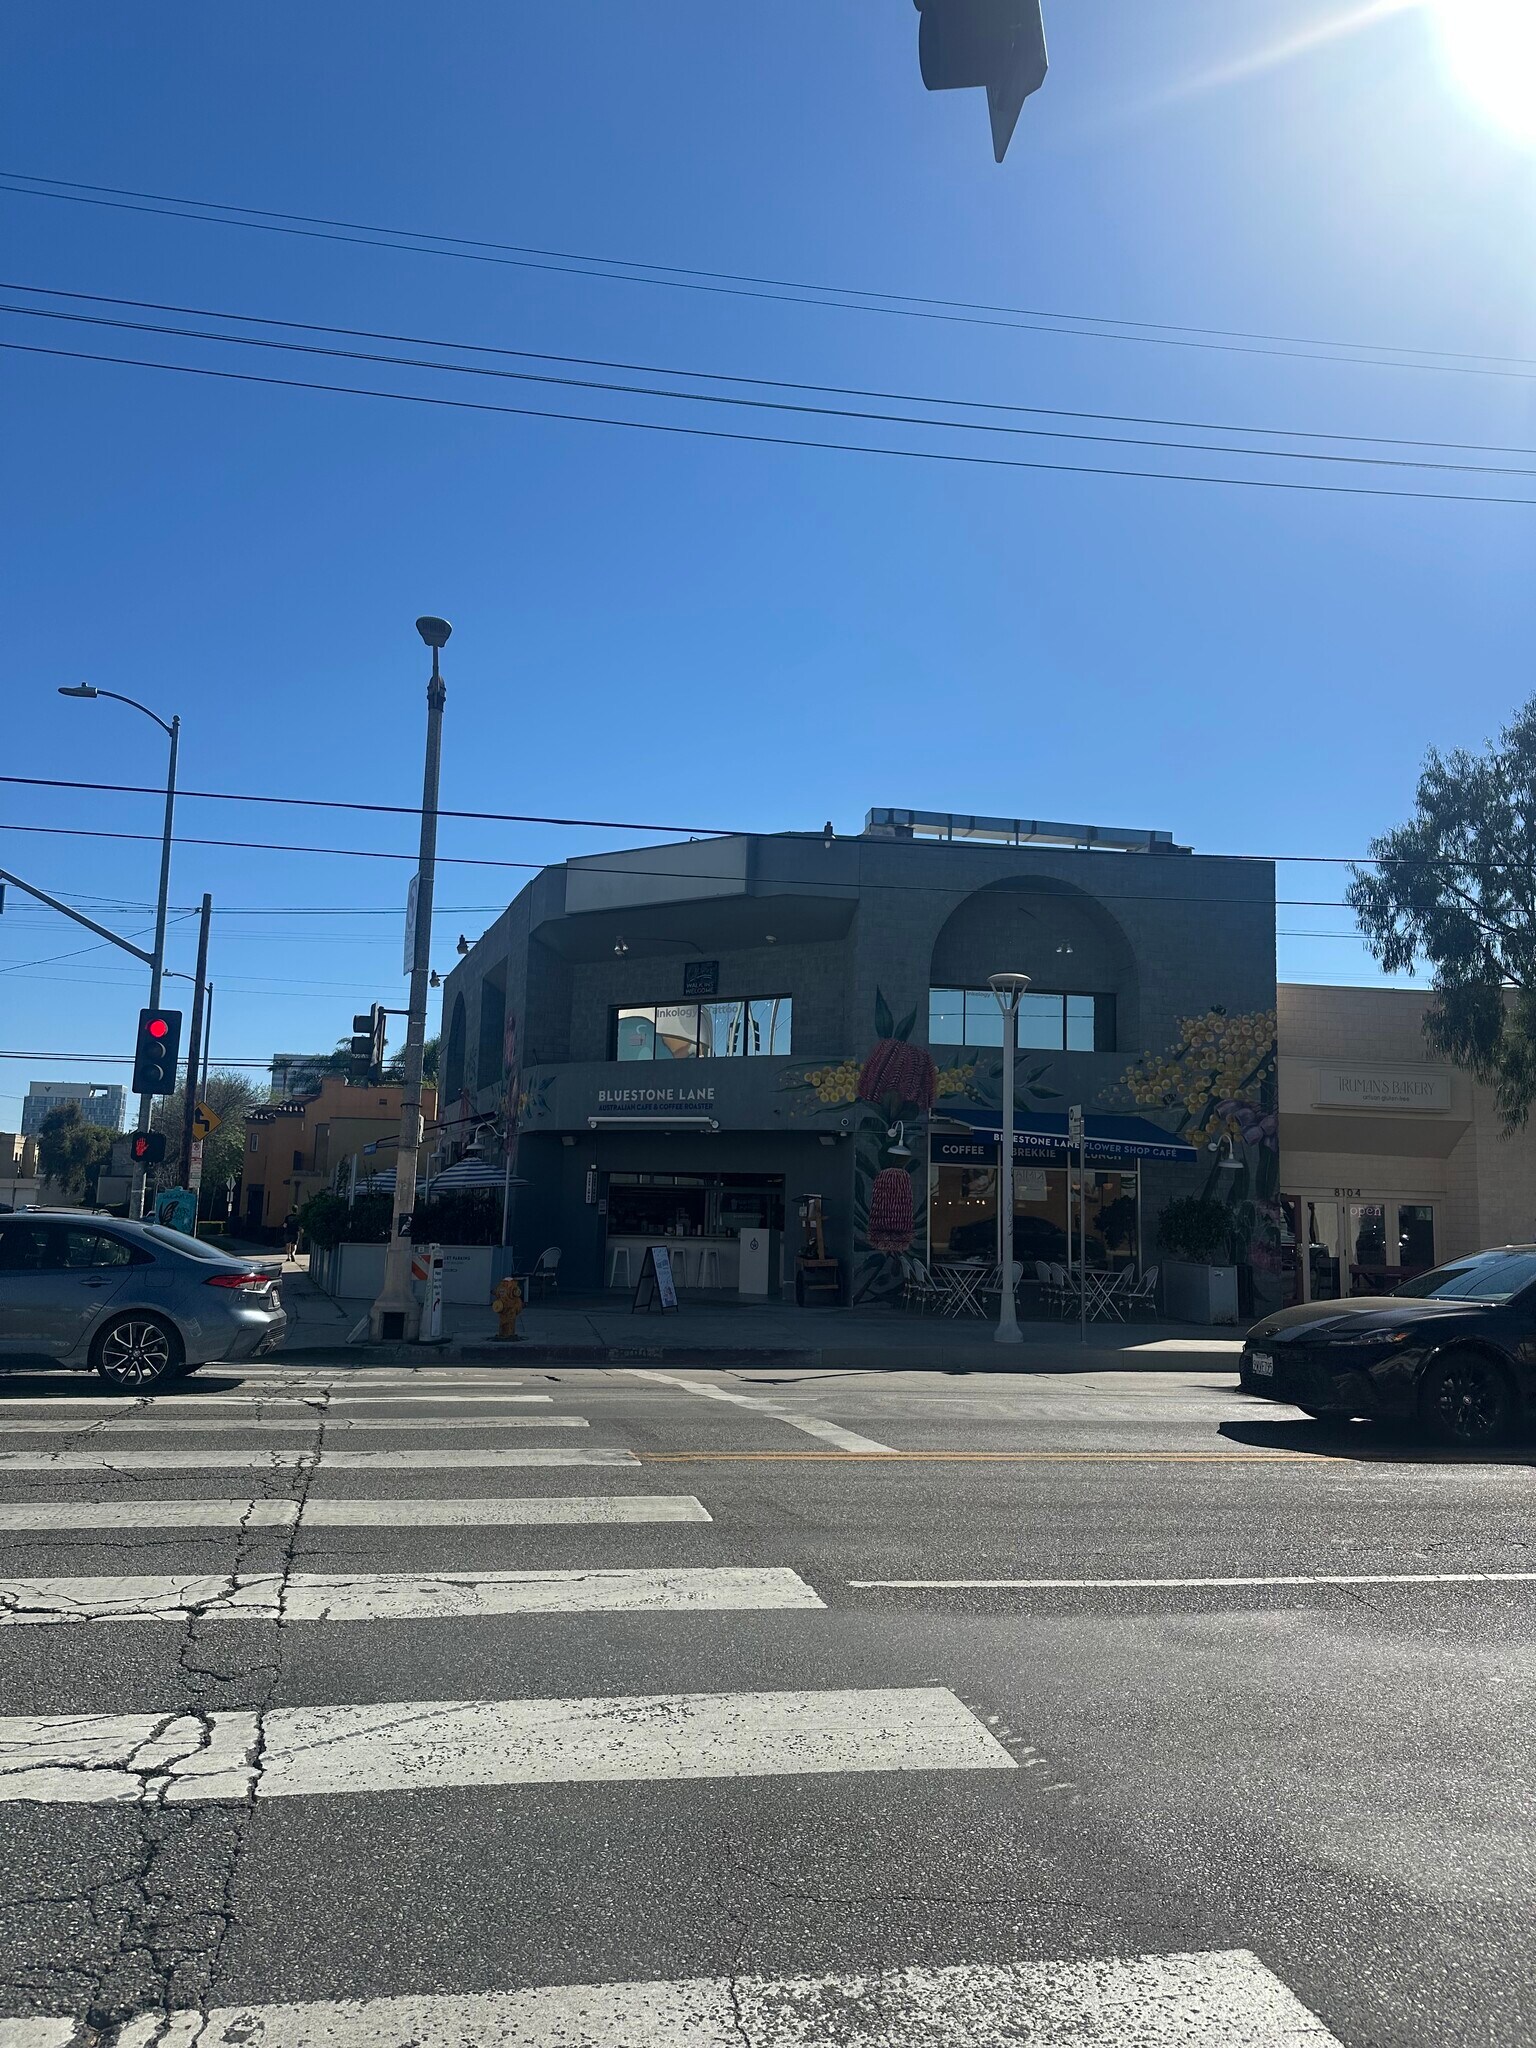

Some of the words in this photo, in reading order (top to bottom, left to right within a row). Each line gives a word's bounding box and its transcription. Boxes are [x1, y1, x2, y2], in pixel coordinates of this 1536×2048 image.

[656, 1006, 697, 1018] Inkology
[707, 1004, 739, 1015] Tattoo
[1334, 1075, 1391, 1094] TRUMAN'S
[1392, 1080, 1436, 1096] BAKERY
[598, 1088, 674, 1102] BLUESTONE
[679, 1087, 715, 1100] LANE
[598, 1103, 636, 1112] AUSTRALIAN
[659, 1102, 683, 1111] COFFEE
[684, 1102, 714, 1110] ROASTER
[942, 1144, 985, 1155] COFFEE
[993, 1133, 1051, 1147] BLESTONE
[1054, 1138, 1080, 1149] LANE
[1083, 1141, 1121, 1152] FLOWER
[1124, 1145, 1150, 1155] SHOP
[1152, 1148, 1177, 1157] CAFÉ
[1012, 1147, 1057, 1158] BREKKIE
[1334, 1188, 1361, 1198] 8104
[1349, 1206, 1382, 1218] open
[1418, 1210, 1426, 1218] A
